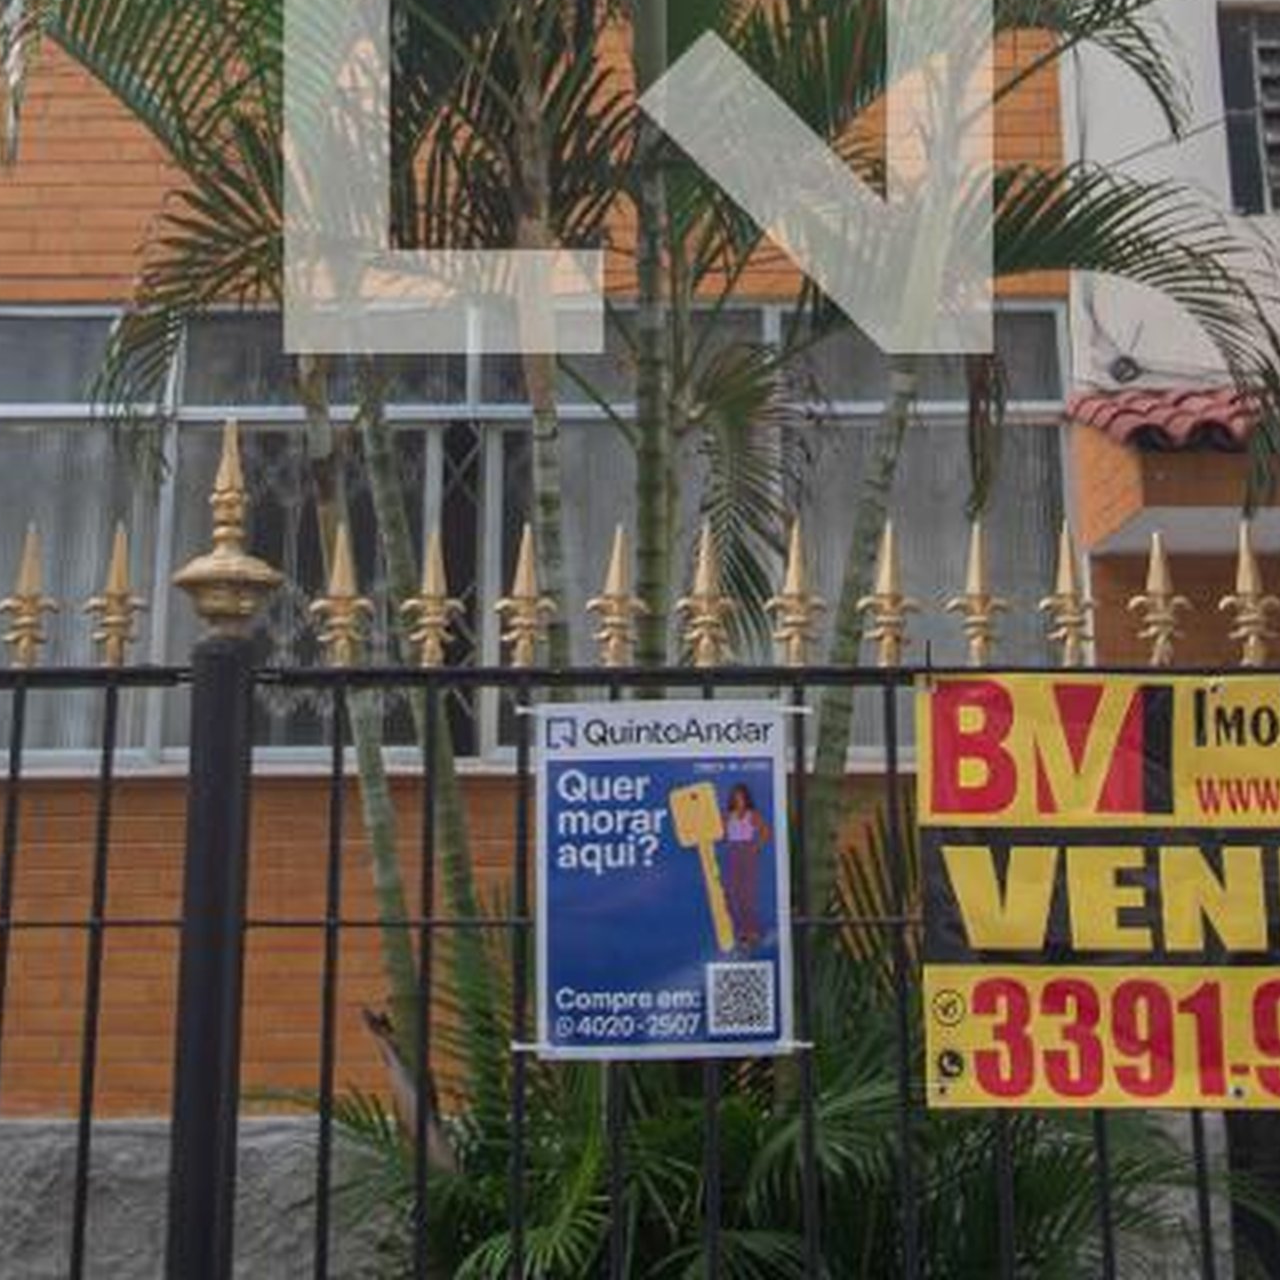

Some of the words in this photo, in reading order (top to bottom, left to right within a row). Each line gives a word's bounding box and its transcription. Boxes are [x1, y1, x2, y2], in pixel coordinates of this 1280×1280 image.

[583, 718, 774, 747] QuintoAndar
[556, 769, 651, 802] Quer
[557, 809, 668, 836] morar
[557, 835, 660, 874] aqui?
[555, 986, 653, 1014] Compra
